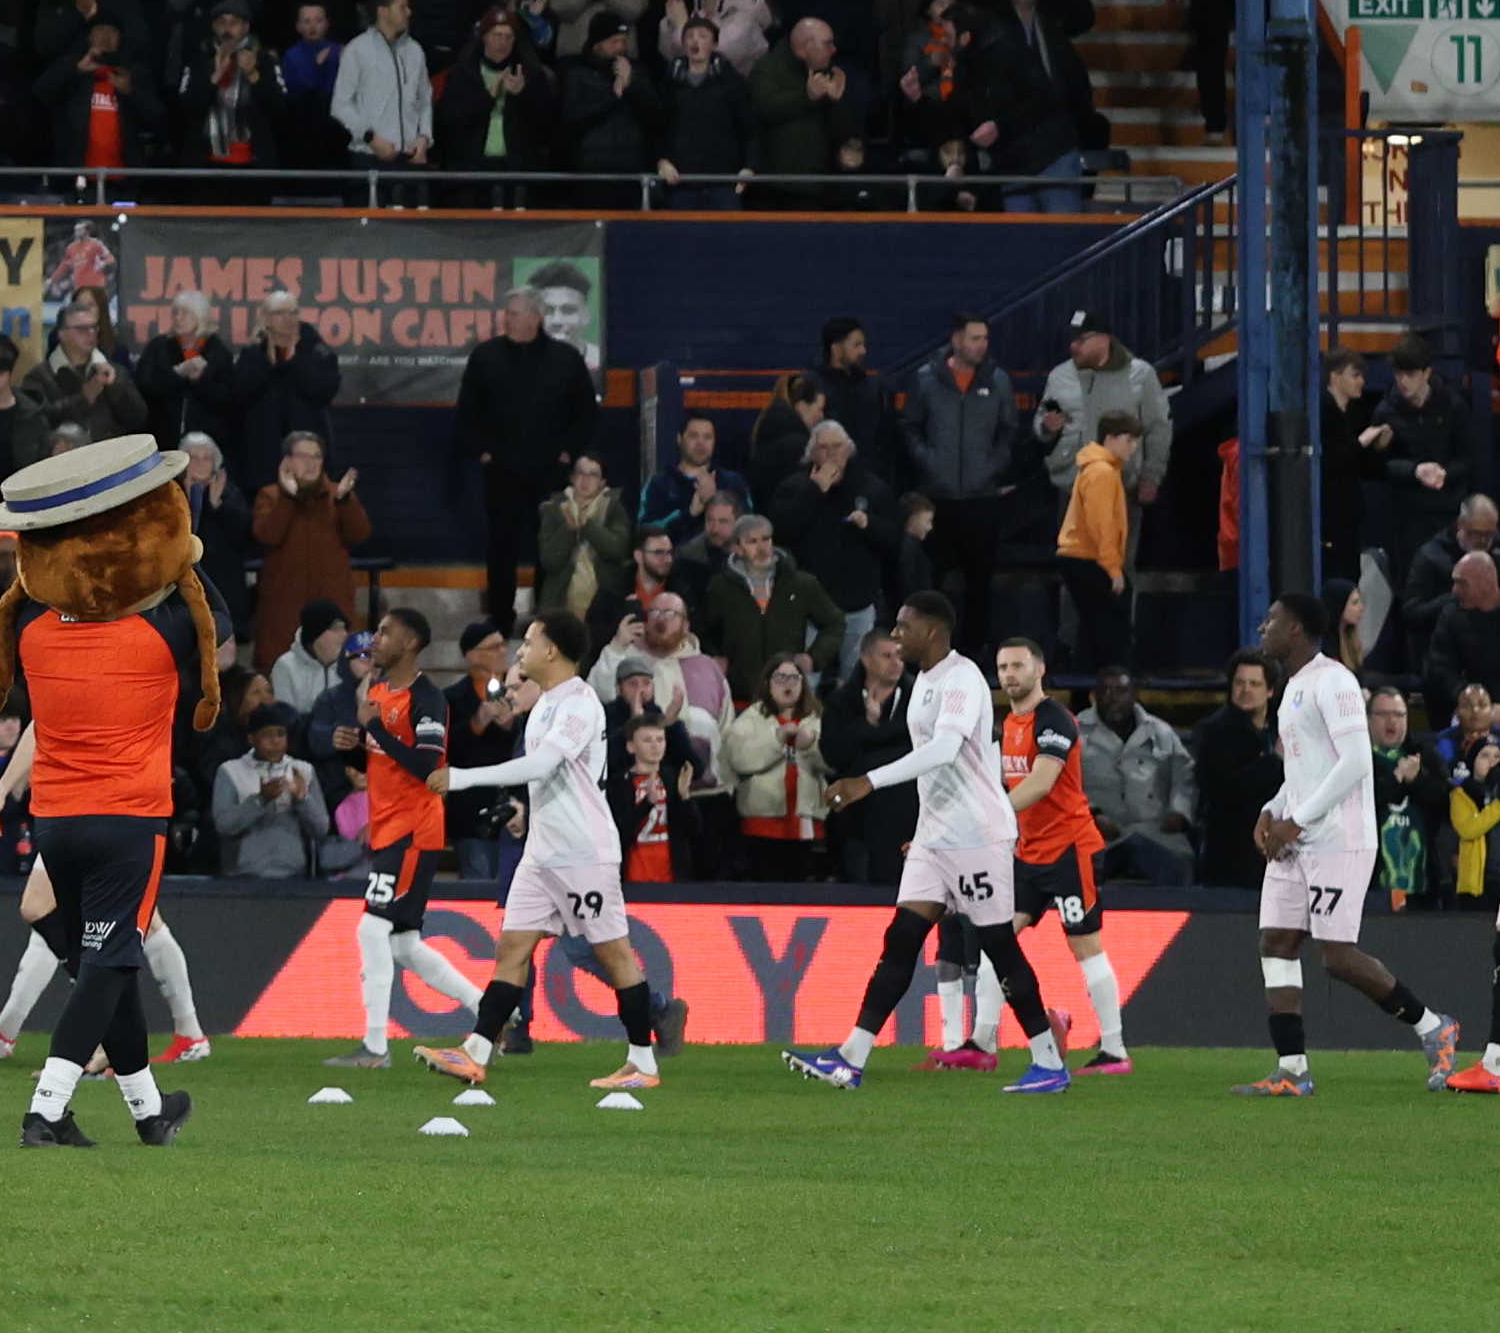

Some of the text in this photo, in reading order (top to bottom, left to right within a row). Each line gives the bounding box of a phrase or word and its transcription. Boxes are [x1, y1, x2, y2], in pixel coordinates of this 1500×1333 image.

[1450, 35, 1482, 84] 11
[140, 257, 496, 303] JAMES JUSTIN
[365, 872, 396, 902] 25
[959, 872, 994, 901] 45
[1309, 886, 1343, 916] 27
[568, 891, 602, 919] 29
[1055, 896, 1084, 923] 18
